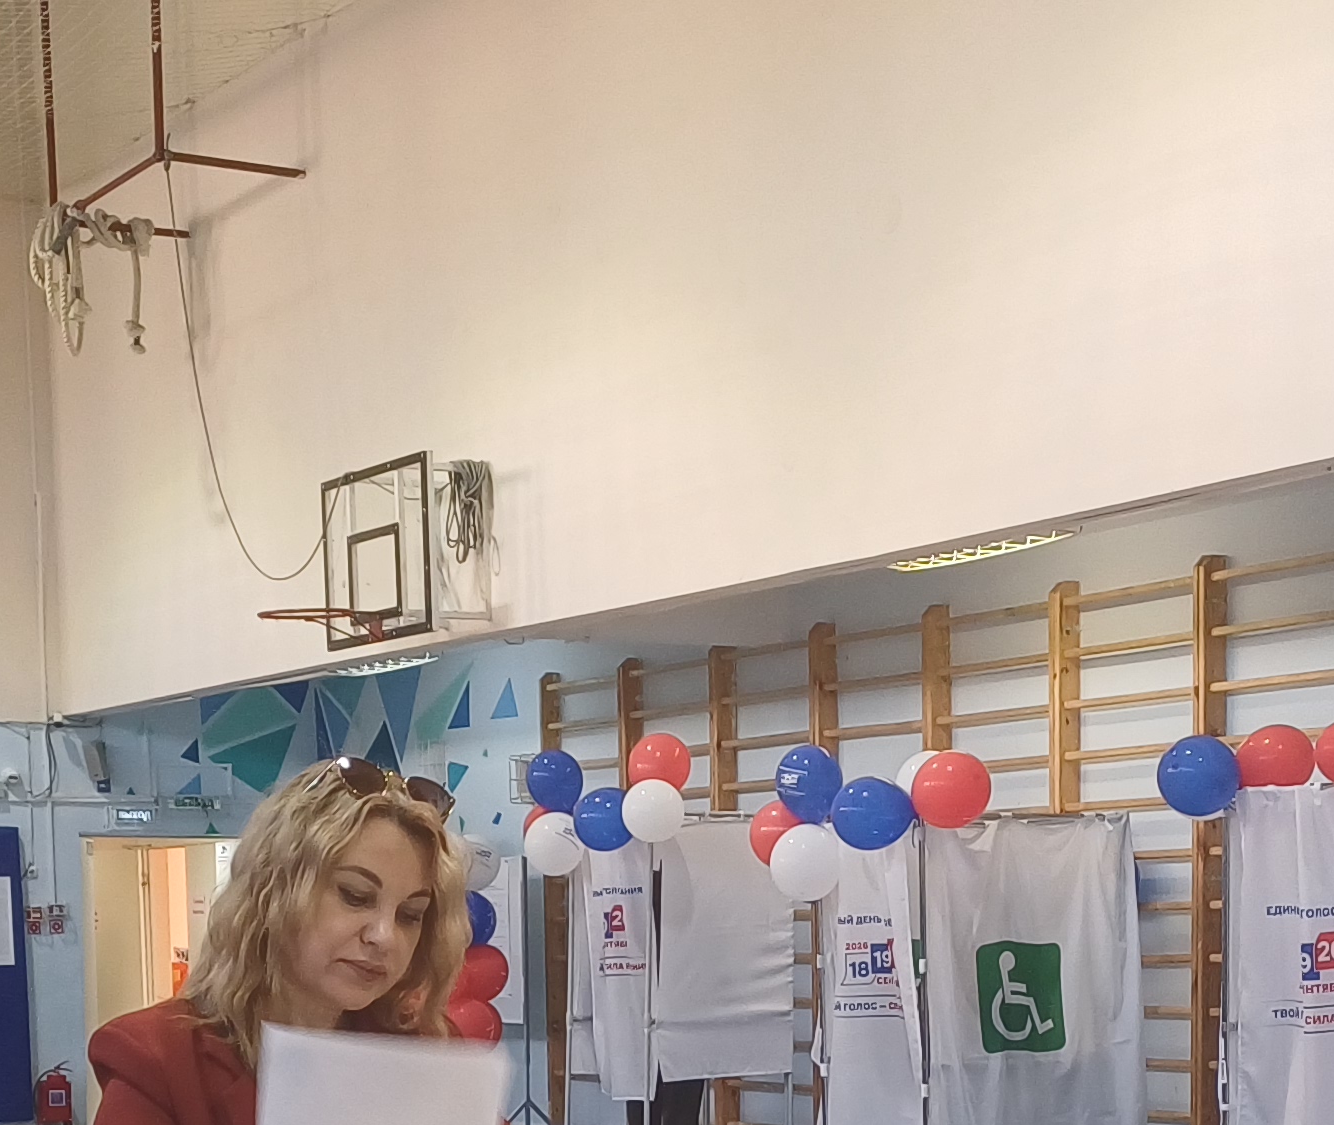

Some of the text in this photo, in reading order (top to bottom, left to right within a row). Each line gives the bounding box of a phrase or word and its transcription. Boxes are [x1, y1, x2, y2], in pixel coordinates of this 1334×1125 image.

[855, 915, 882, 925] ДЕНЬ
[849, 950, 891, 978] 18 19
[843, 1002, 878, 1012] ГОЛОС
